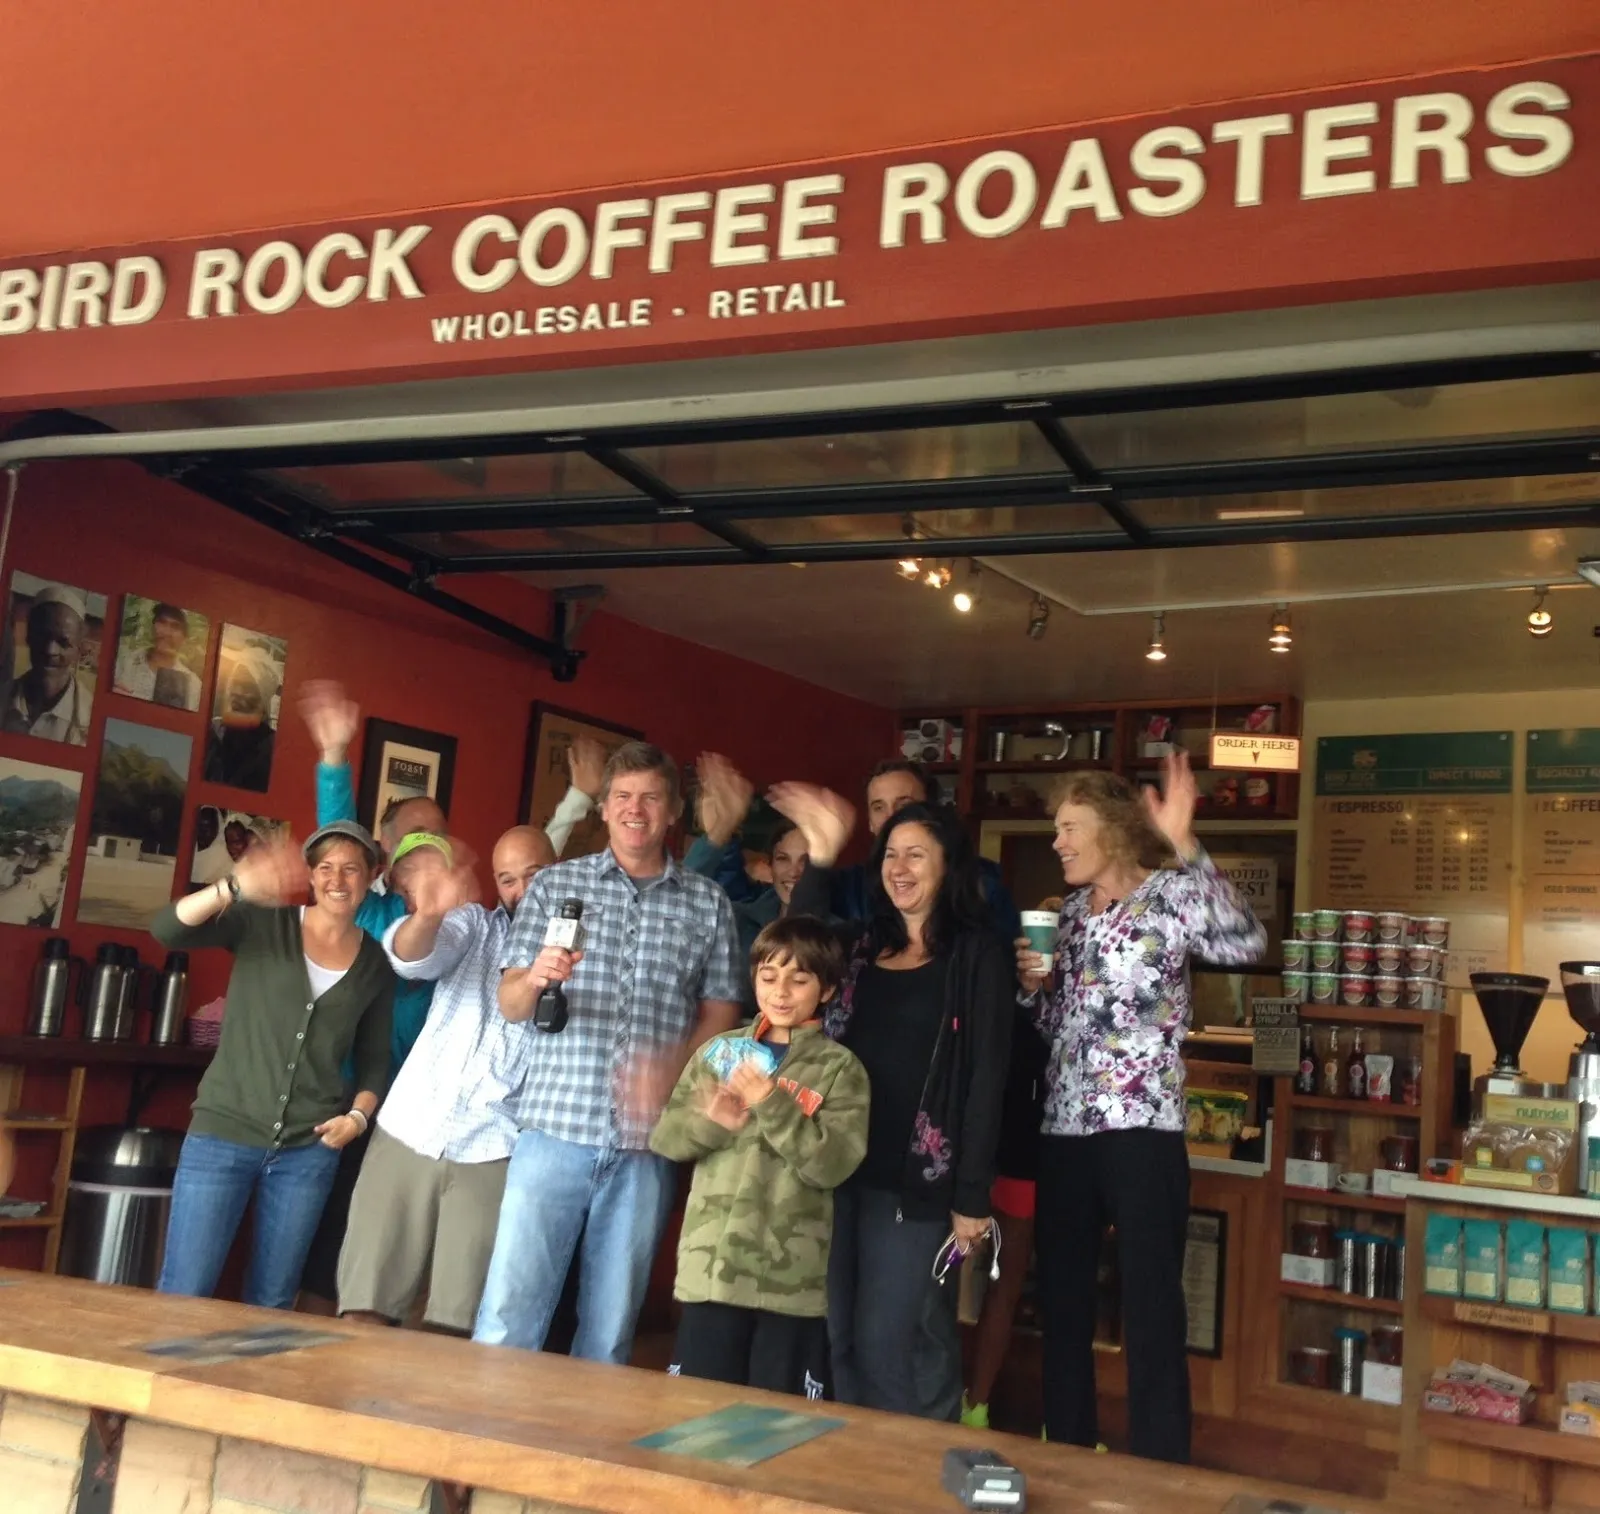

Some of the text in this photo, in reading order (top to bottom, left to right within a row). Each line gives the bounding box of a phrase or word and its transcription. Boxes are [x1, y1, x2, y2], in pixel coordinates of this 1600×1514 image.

[0, 81, 1575, 338] BIRD ROCK COFFEE ROASTERS
[431, 298, 652, 344] WHOLESALE
[708, 280, 847, 319] RETAIL
[1216, 738, 1296, 751] ORDER HERE
[393, 761, 425, 775] roast
[1336, 800, 1405, 813] ESPRESSO
[1551, 799, 1600, 813] COFFE
[1235, 881, 1271, 897] EST
[1255, 1003, 1298, 1015] VANILLA
